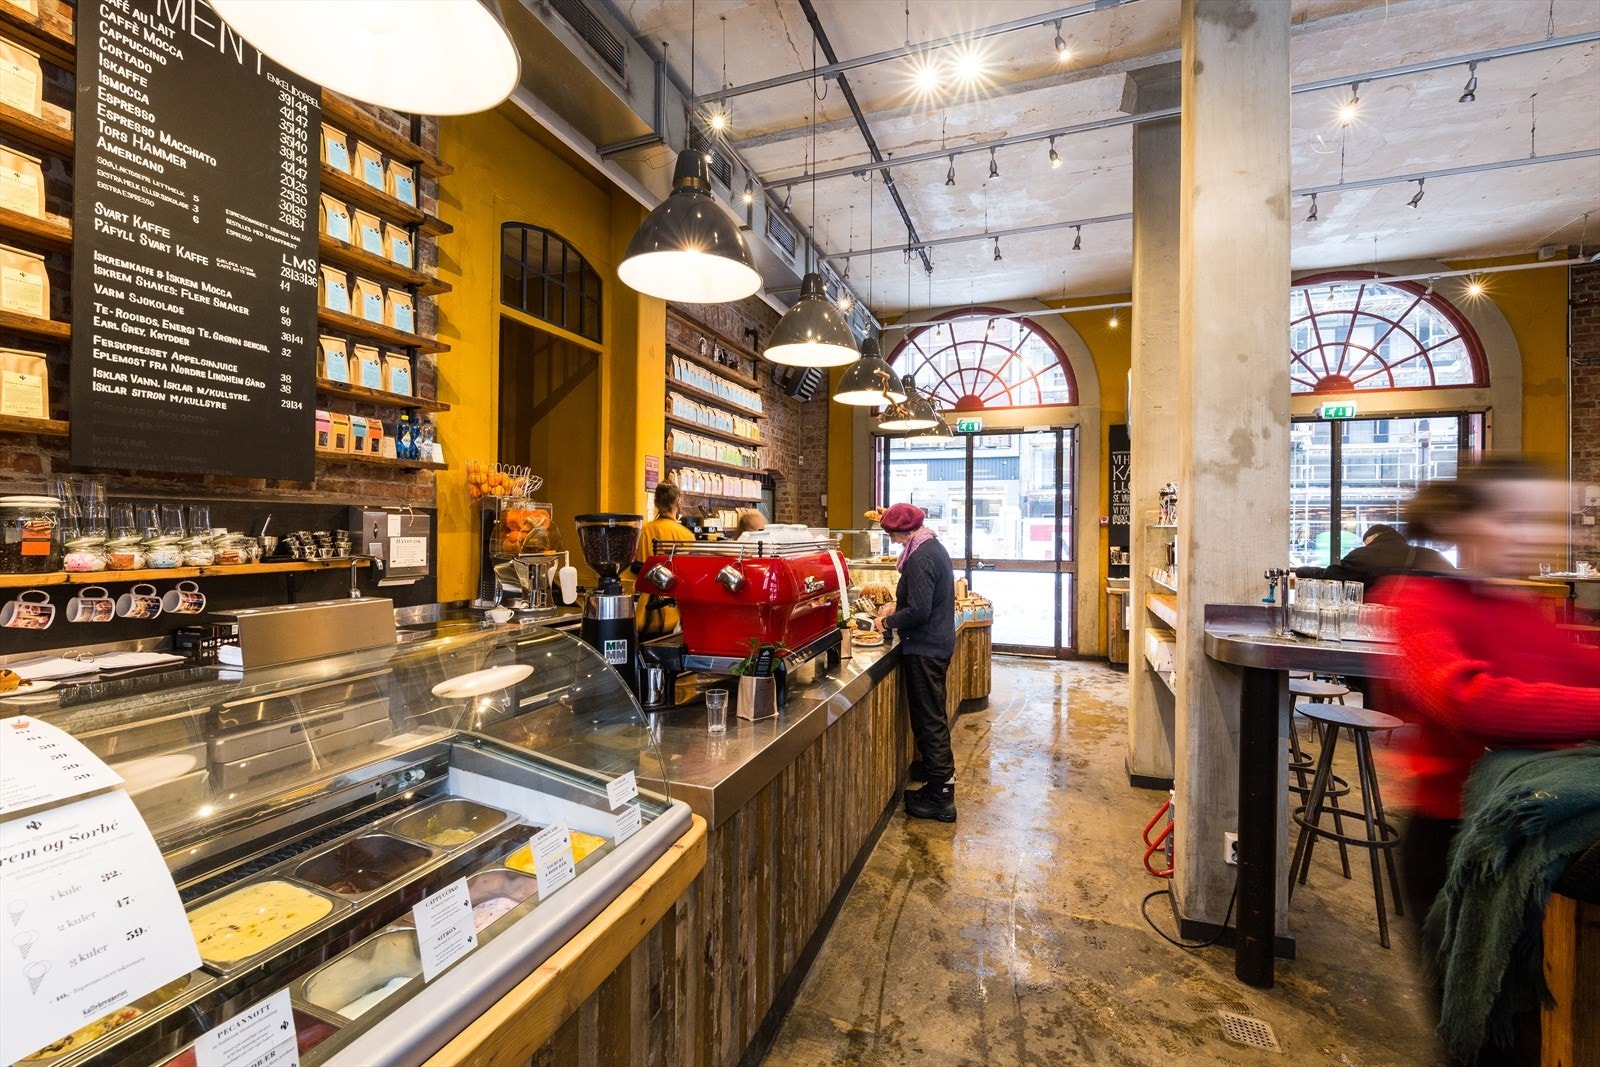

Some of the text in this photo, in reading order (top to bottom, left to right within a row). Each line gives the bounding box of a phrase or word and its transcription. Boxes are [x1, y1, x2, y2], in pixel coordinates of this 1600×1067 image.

[102, 0, 175, 39] AFÉ AU LAIT
[99, 21, 167, 65] CAPPUCCINO
[99, 37, 152, 73] CORTADO
[144, 27, 183, 60] MOCCA
[98, 69, 150, 105] ISMOCCA
[99, 52, 148, 87] ISKAFFE
[98, 85, 155, 123] ESPRESSO
[97, 104, 216, 167] ESPRESSO MACCHIATO
[97, 118, 187, 169] TORS HAMMER
[97, 136, 164, 174] AMERICANO
[95, 202, 170, 239] SVART KAFFE
[193, 215, 199, 224] 6
[95, 217, 209, 266] PÅFYLL SVART KAFFE
[94, 250, 155, 277] ISKREMKAFFE
[156, 270, 164, 278] &
[166, 271, 198, 289] ISKREM
[202, 282, 232, 299] MOCCA
[94, 264, 132, 284] ISKREM
[136, 276, 178, 296] SHAKES:
[181, 288, 210, 305] FLERE
[213, 298, 249, 316] SMAKER
[94, 283, 125, 300] VARM
[129, 293, 185, 315] SJOKOLADE
[94, 316, 120, 331] EARL
[150, 329, 190, 346] KRYDDER
[162, 319, 195, 336] ENERGI
[281, 348, 292, 357] 32
[93, 335, 291, 383] FERSKPRESSET APPELSINJUICE 38
[93, 349, 146, 367] EPLEMOST
[149, 360, 168, 371] FRA
[171, 363, 206, 378] NORDRE
[208, 370, 243, 385] LINDHEIM
[280, 384, 291, 394] 38
[93, 368, 128, 383] ISKLAR
[164, 380, 193, 393] ISKLAR
[93, 381, 227, 410] ISKLAR SITRON M/KULLSYRE
[1113, 455, 1121, 464] VI
[43, 840, 64, 852] og
[69, 819, 118, 844] Sorbé
[57, 885, 82, 898] kule
[425, 886, 458, 908] CAPPUCCINO
[66, 911, 96, 928] kuler
[69, 958, 78, 968] 3
[79, 944, 108, 962] kuler
